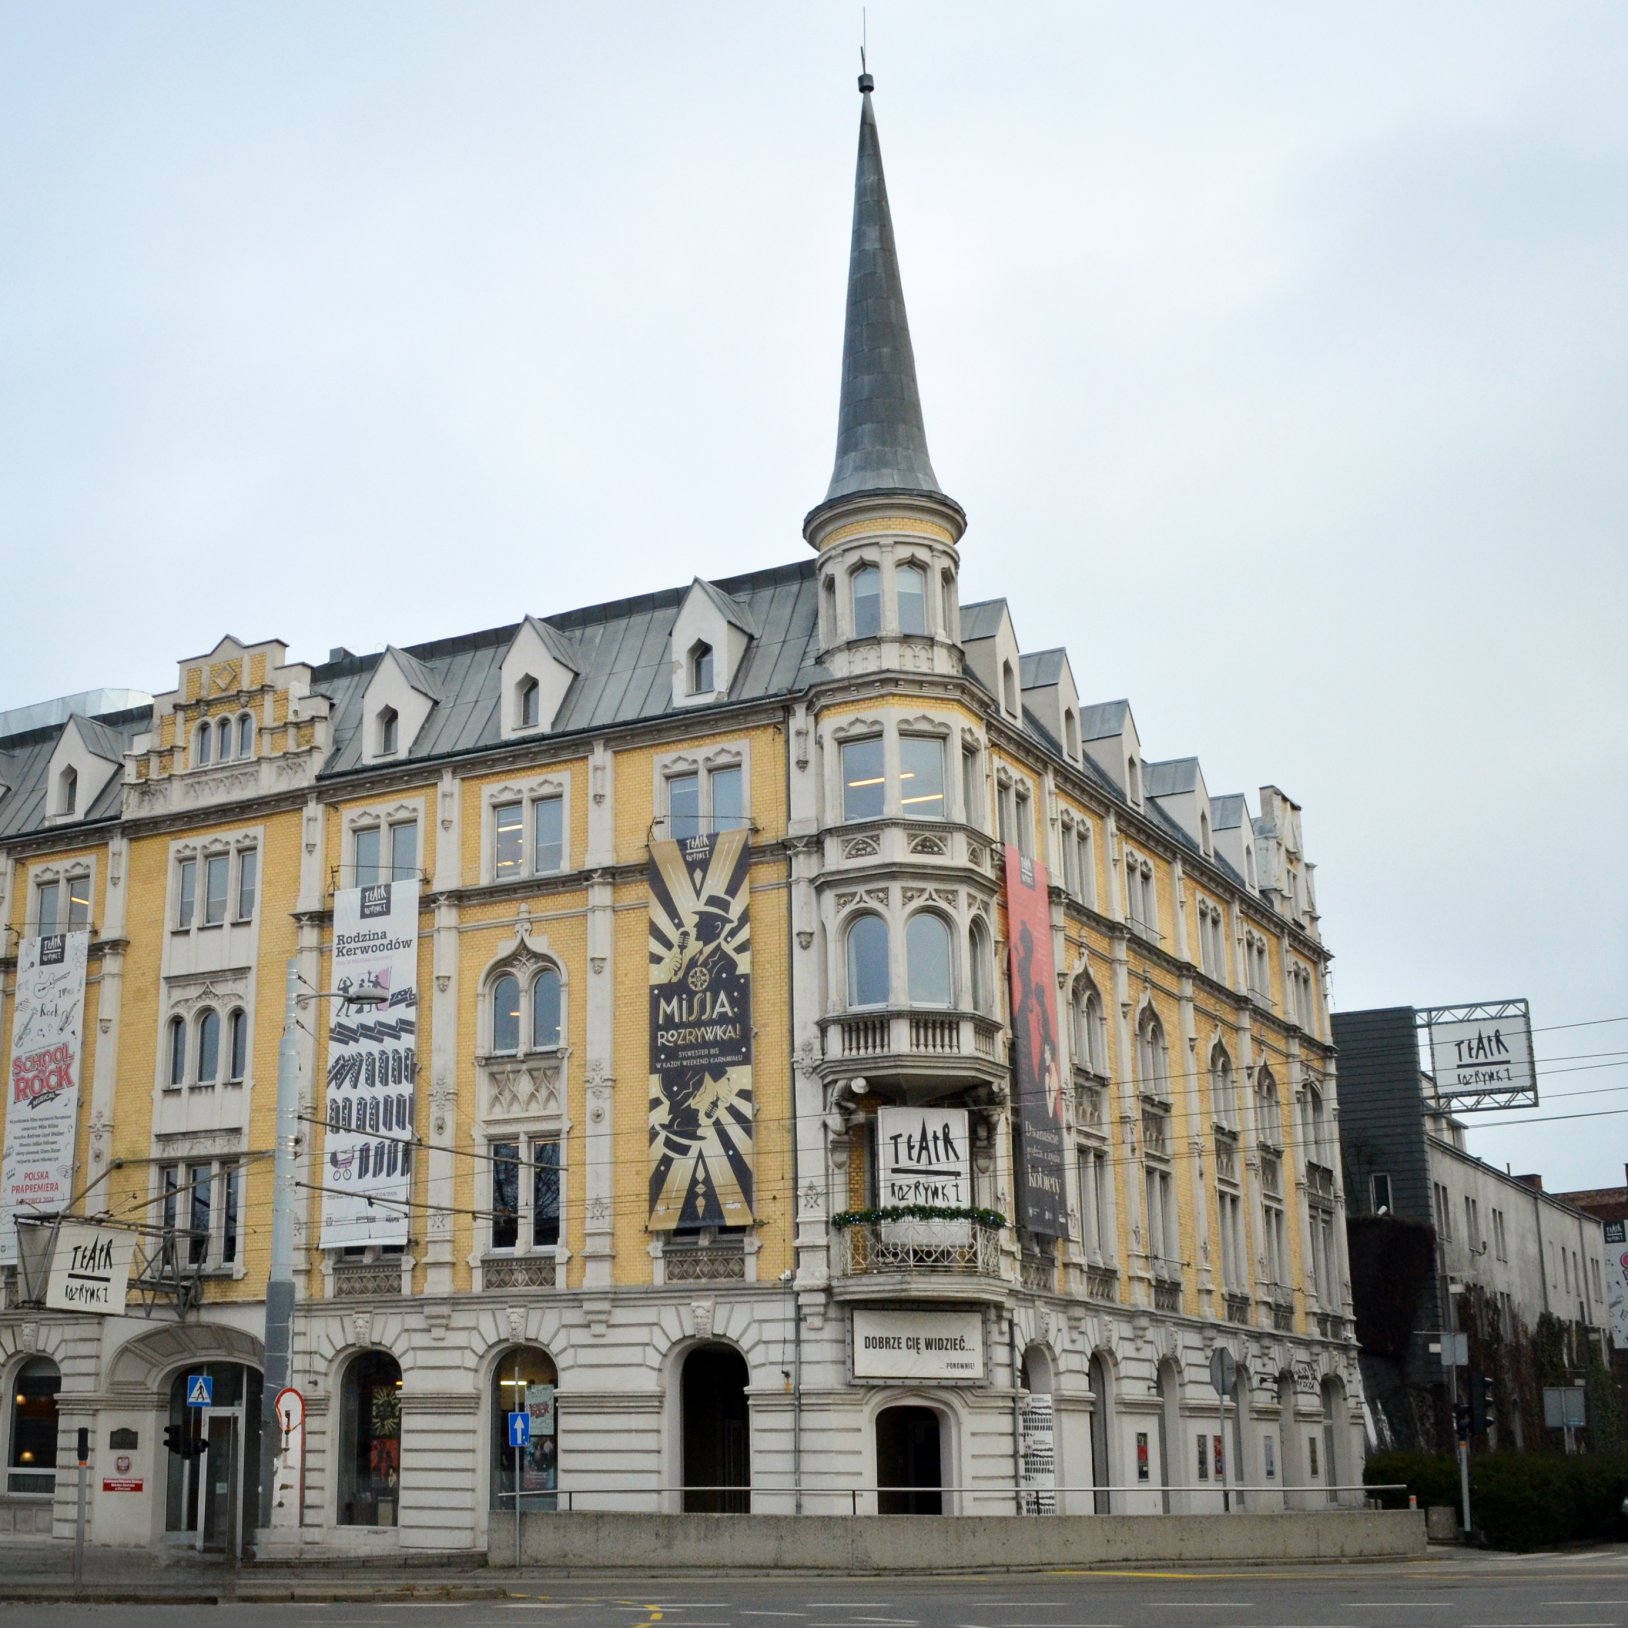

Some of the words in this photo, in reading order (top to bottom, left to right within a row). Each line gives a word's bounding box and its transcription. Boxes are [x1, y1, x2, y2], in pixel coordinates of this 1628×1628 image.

[336, 930, 387, 945] Rodzina
[336, 938, 413, 957] Kerwoodów
[678, 1049, 709, 1058] SYLWESTER
[709, 1047, 719, 1055] BIS
[1454, 1028, 1509, 1062] TEATR
[12, 1042, 74, 1075] SCHOOL
[663, 1060, 680, 1068] KAŻDY
[682, 1058, 709, 1066] WEEKEND
[710, 1055, 743, 1063] KARNAWAŁU
[14, 1062, 75, 1104] ROCK
[1457, 1067, 1512, 1086] ROZRYWKI
[889, 1117, 960, 1165] TEATR
[24, 1171, 49, 1181] POLSKA
[1028, 1164, 1061, 1200] kobiety
[11, 1182, 59, 1194] PRAPREMIERA
[891, 1177, 962, 1204] ROZRYWKI
[71, 1232, 113, 1272] TEATR
[864, 1336, 902, 1349] DOBRZE
[906, 1337, 921, 1355] CIĘ
[925, 1335, 975, 1351] WIDZIEĆ...
